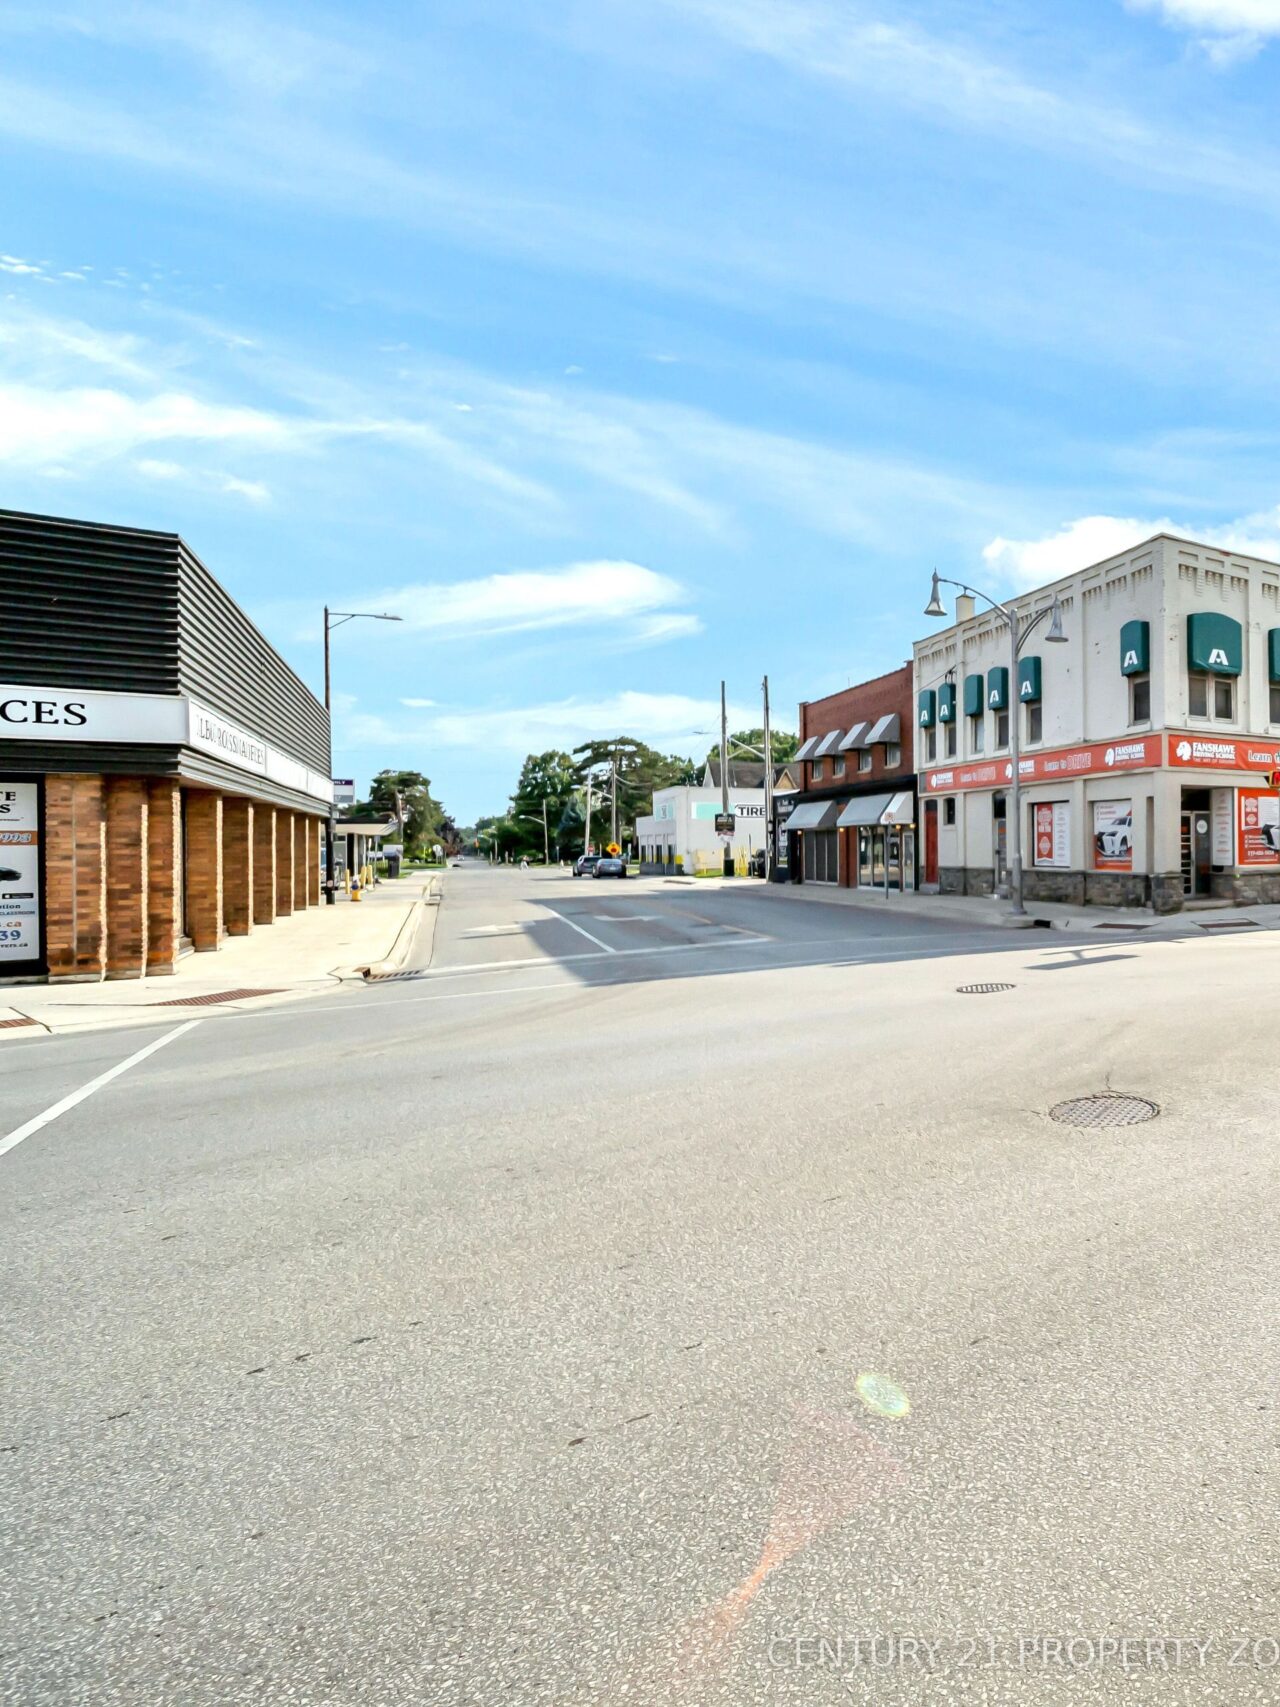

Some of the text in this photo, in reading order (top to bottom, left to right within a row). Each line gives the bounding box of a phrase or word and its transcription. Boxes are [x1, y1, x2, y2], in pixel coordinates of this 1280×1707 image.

[1208, 648, 1229, 665] A
[0, 699, 87, 726] CES
[1193, 742, 1235, 753] FANSHAWE
[1248, 749, 1272, 763] Learn
